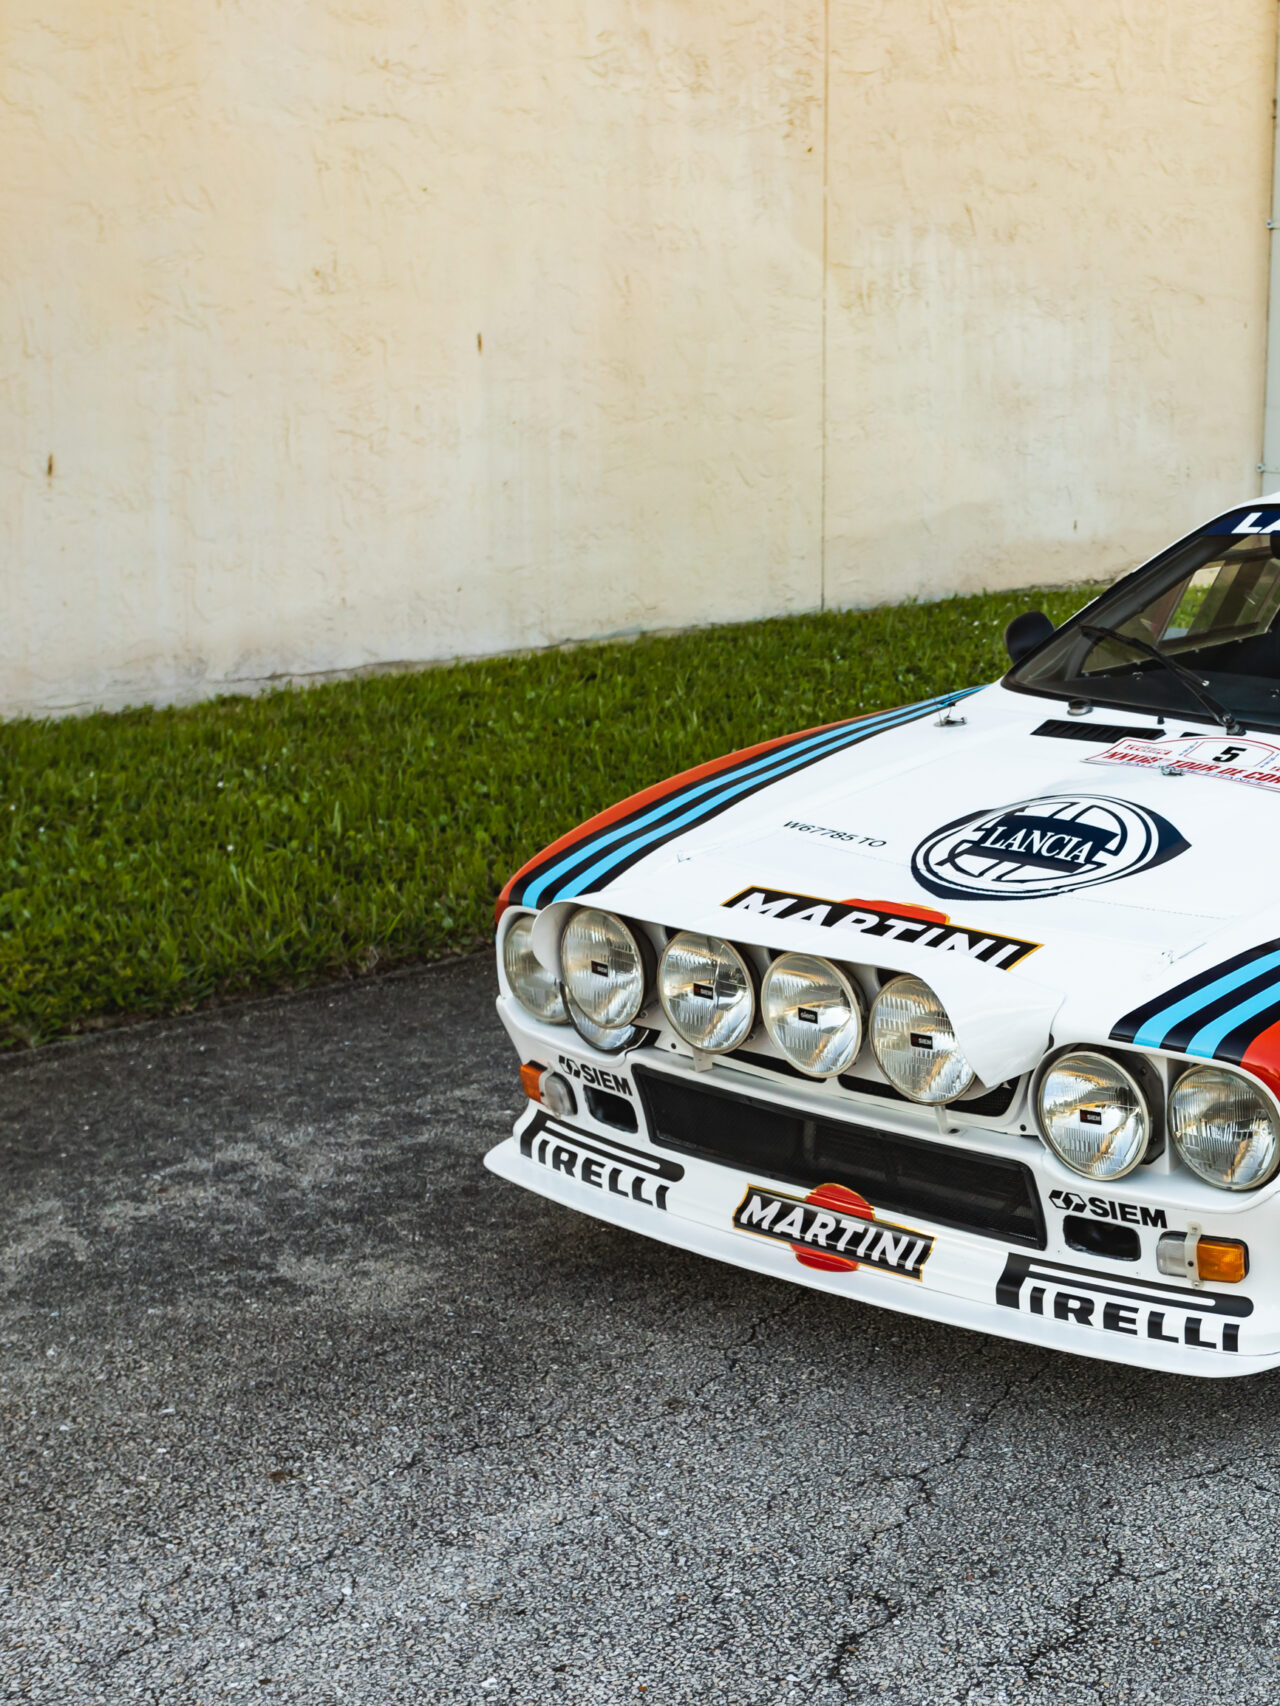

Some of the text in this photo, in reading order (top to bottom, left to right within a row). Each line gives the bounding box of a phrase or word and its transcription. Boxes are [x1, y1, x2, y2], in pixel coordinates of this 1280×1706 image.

[1168, 760, 1221, 771] TOUR
[1217, 767, 1247, 776] DE
[1212, 746, 1247, 762] 5
[783, 820, 887, 848] W67785 TO
[980, 826, 1096, 865] LANCIA
[733, 891, 1022, 970] MARTINI
[580, 1063, 633, 1097] SIEM
[520, 1109, 686, 1211] PIRELLI
[1088, 1196, 1168, 1229] SIEM
[740, 1195, 926, 1271] MARTINI
[996, 1252, 1255, 1353] PIRELLI
